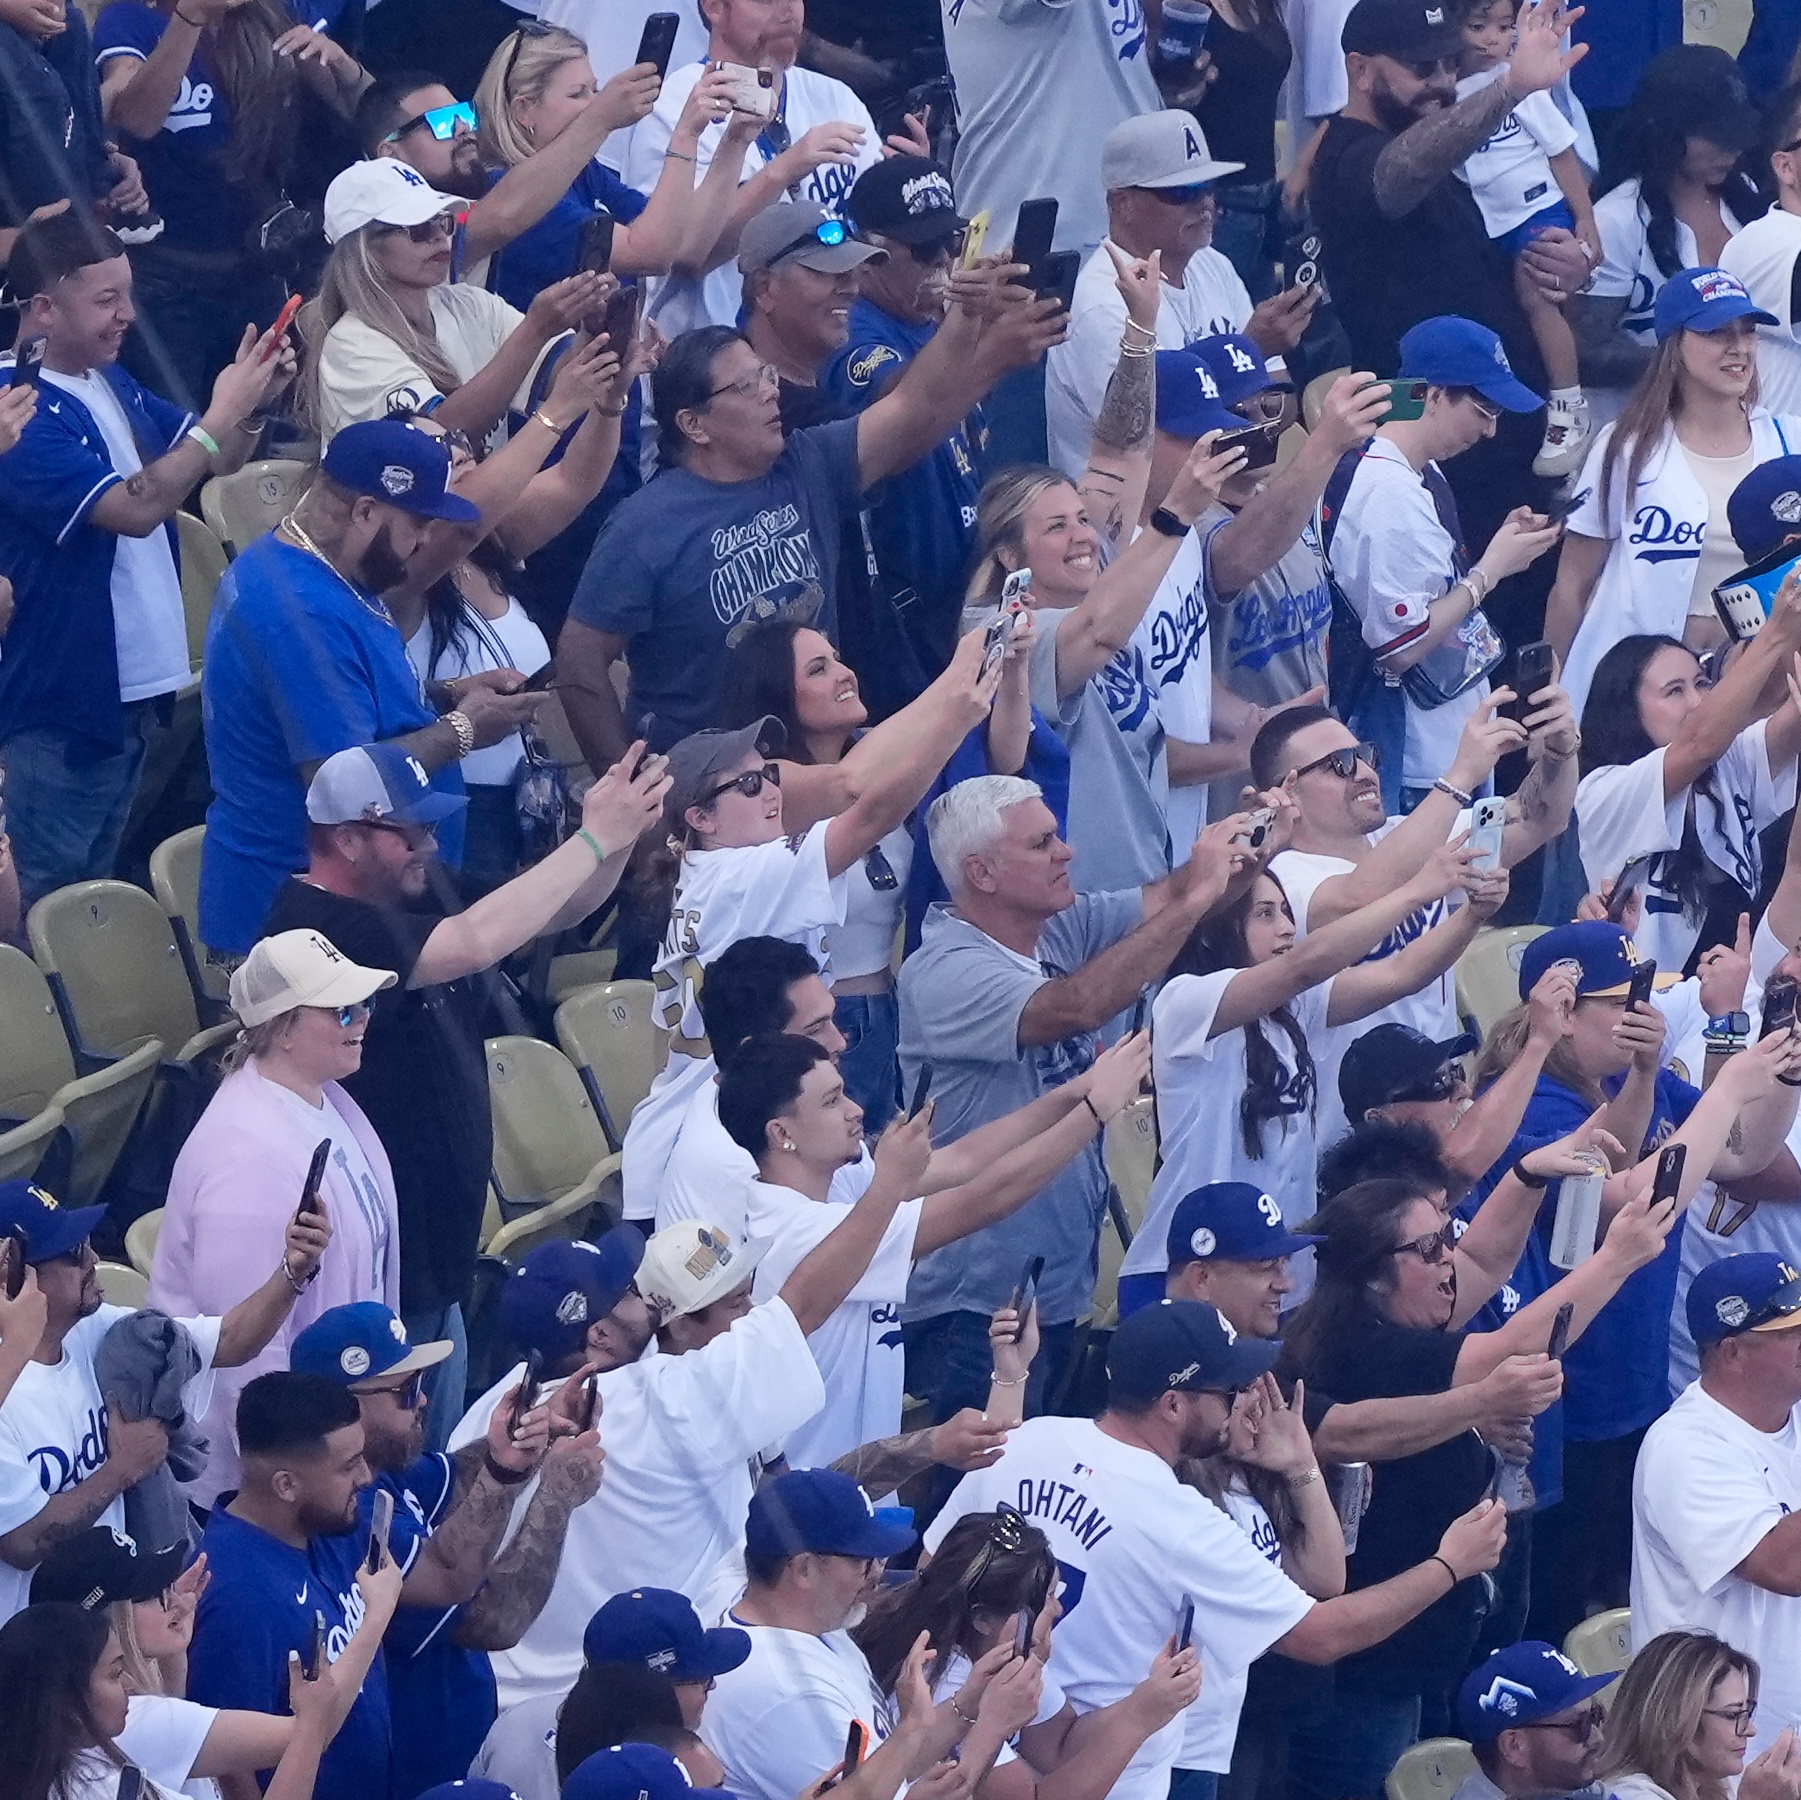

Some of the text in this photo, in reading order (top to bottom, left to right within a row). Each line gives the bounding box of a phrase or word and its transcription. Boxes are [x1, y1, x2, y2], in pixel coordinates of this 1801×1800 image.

[1224, 343, 1256, 373] LA
[1195, 367, 1220, 399] LA
[612, 1005, 627, 1022] 10
[27, 1186, 59, 1211] LA
[1018, 1478, 1113, 1552] OHTANI
